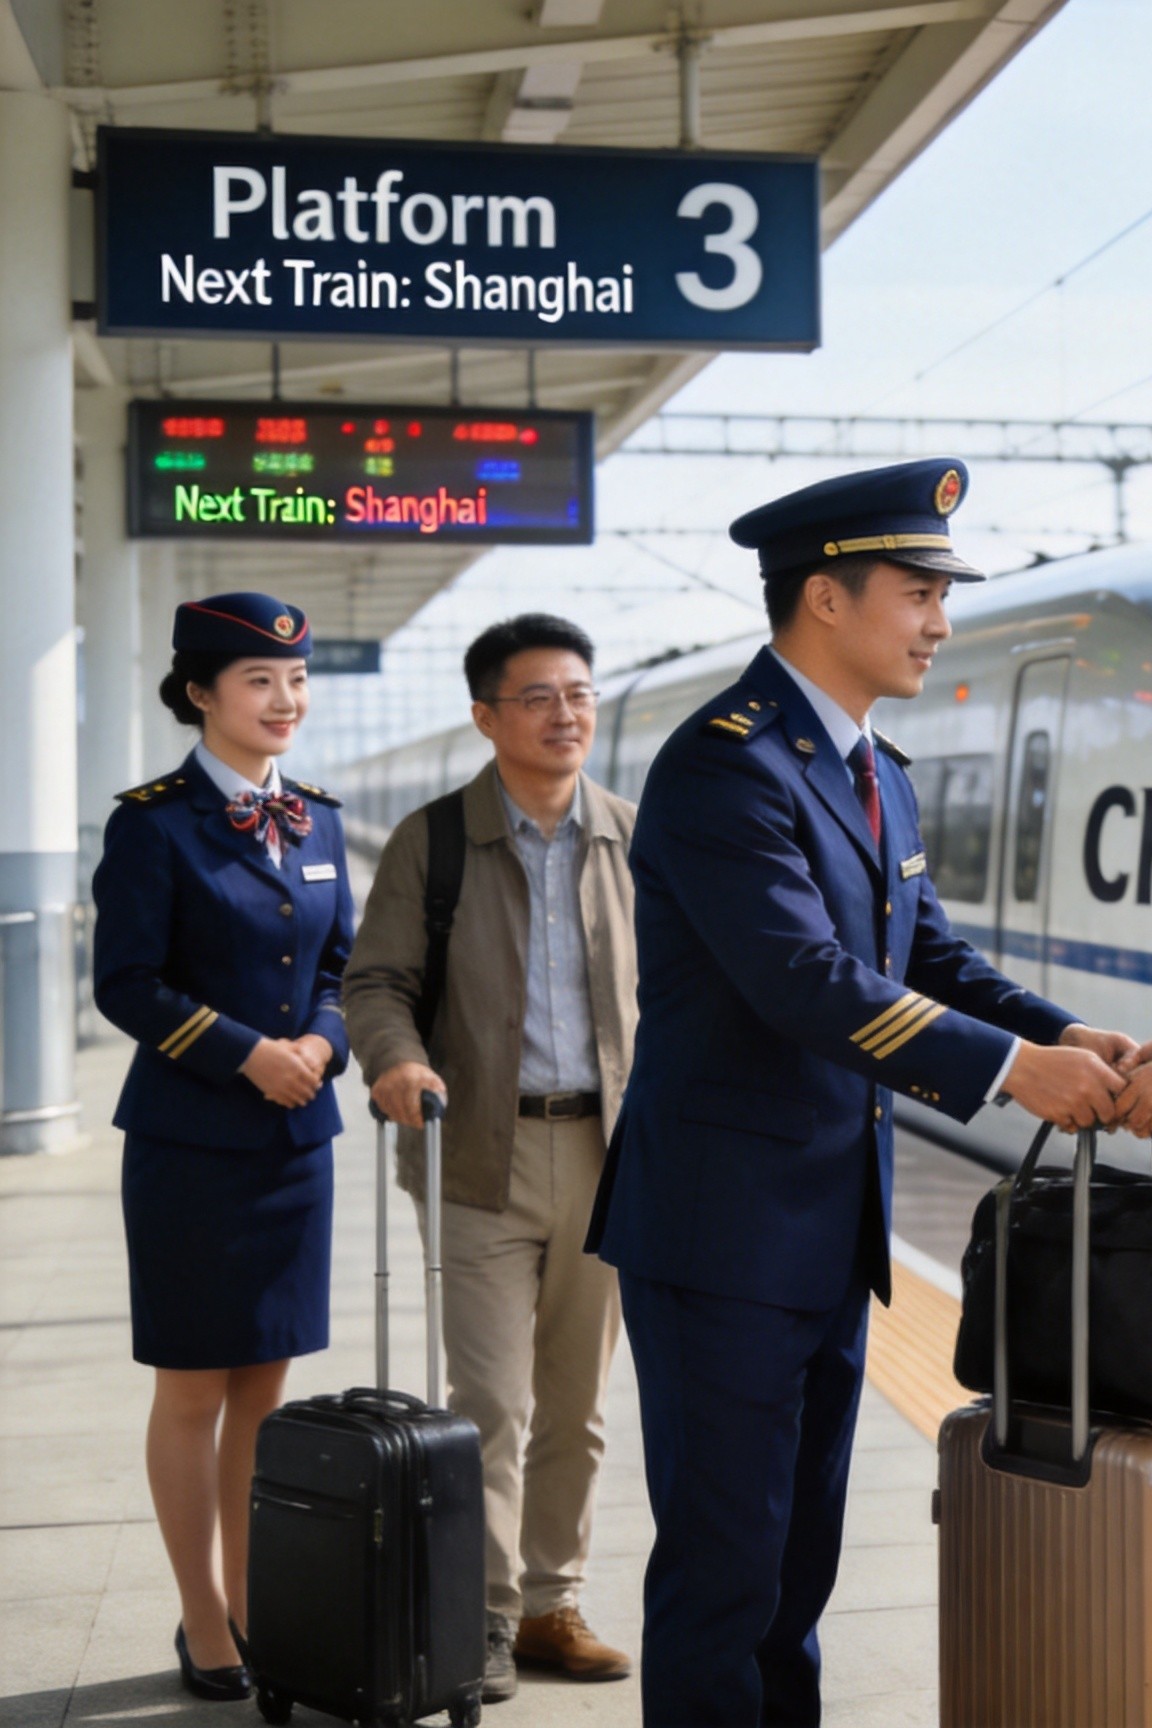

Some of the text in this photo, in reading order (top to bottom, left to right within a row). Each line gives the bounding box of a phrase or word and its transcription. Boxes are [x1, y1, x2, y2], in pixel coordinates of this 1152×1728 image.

[213, 166, 763, 311] Platform 3
[161, 254, 634, 323] Next Train: Shanghai
[174, 484, 488, 533] Next Train: Shanghai
